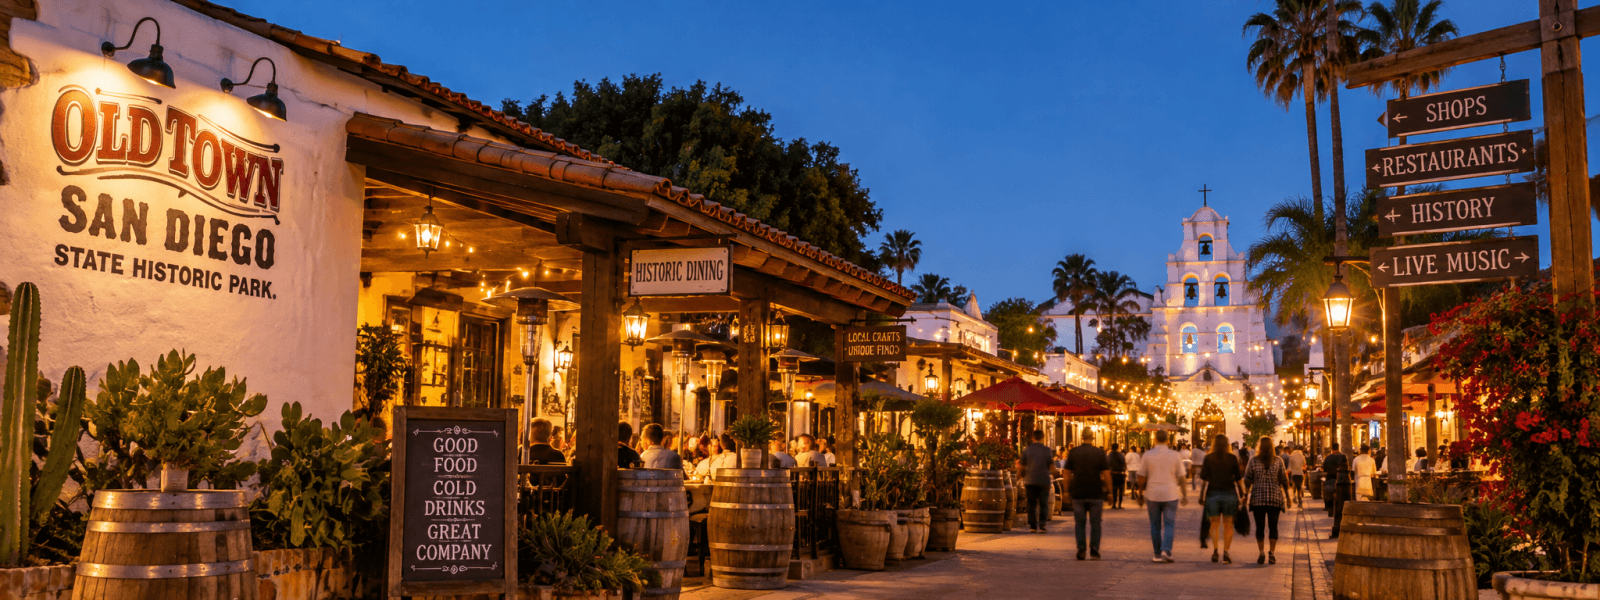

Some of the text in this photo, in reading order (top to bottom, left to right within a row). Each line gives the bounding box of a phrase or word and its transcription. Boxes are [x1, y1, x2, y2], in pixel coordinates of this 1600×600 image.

[1426, 95, 1488, 123] SHOPS
[51, 86, 284, 213] OLD TOWN
[1382, 142, 1520, 177] RESTAURANTS
[1411, 196, 1496, 224] HISTORY
[58, 184, 276, 270] SAN DIEGO
[54, 243, 125, 276] STATE
[132, 257, 223, 291] HISTORIC
[635, 259, 724, 283] HISTORIC DINING
[1393, 248, 1511, 277] LIVE MUSIC
[848, 331, 871, 343] LOCAL
[433, 437, 478, 453] GOOD
[433, 457, 478, 473] FOOD
[433, 480, 477, 496] COLD
[424, 500, 485, 516] DRINKS
[427, 523, 482, 540] GREAT
[416, 544, 492, 561] COMPANY
